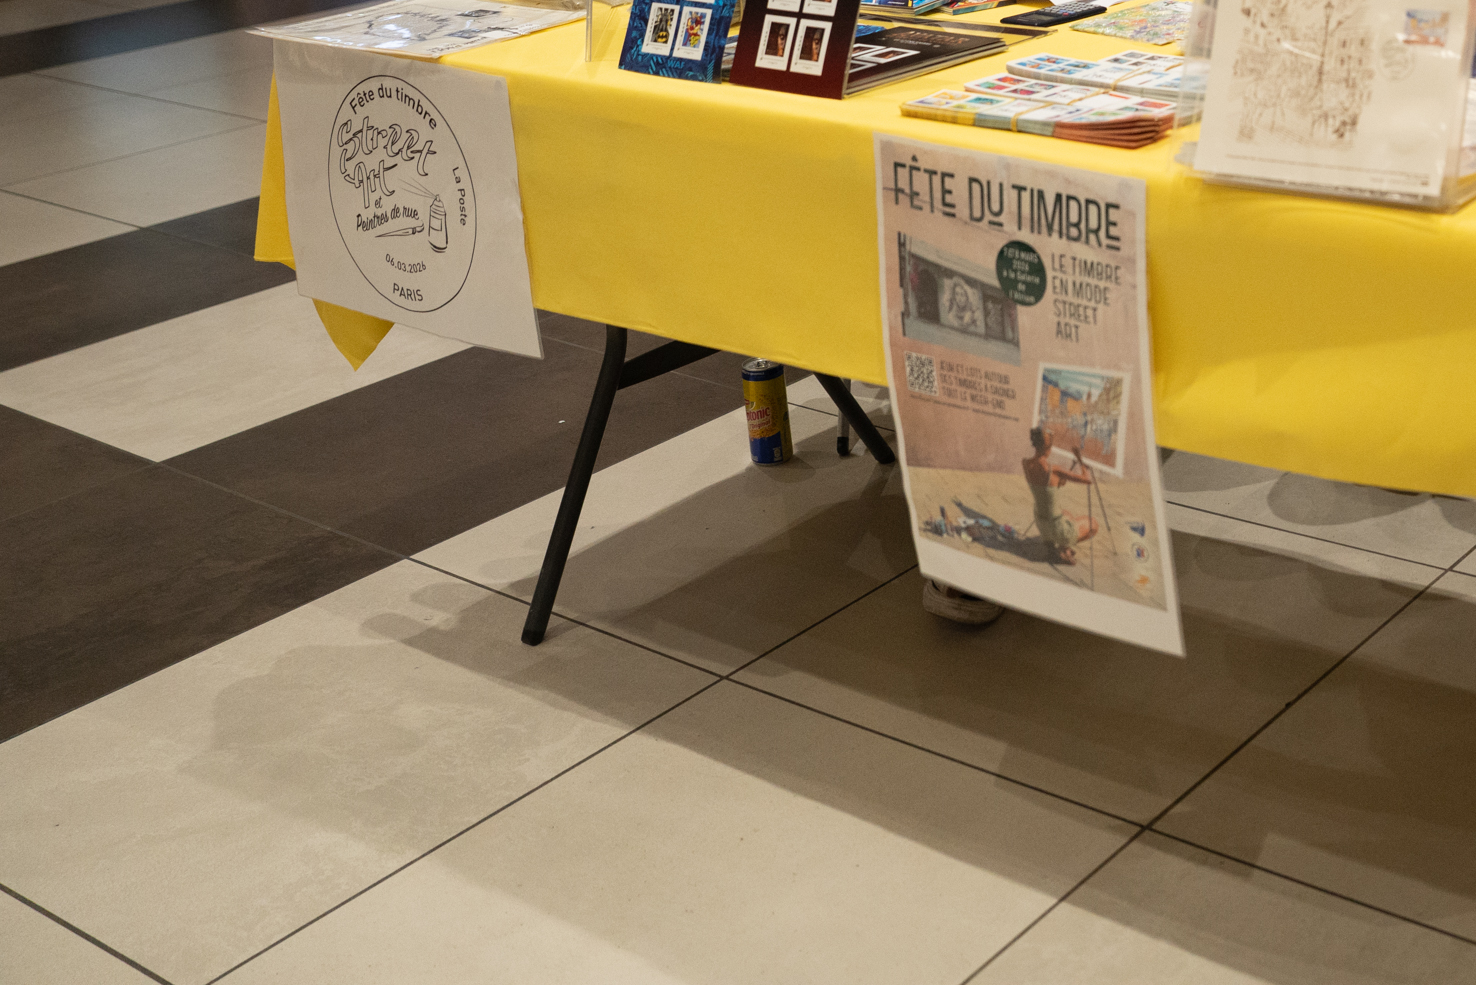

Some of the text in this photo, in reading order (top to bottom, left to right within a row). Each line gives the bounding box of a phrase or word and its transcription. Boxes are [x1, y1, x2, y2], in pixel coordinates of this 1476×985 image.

[349, 83, 437, 130] Fête du timbre
[336, 115, 438, 177] Street
[374, 196, 383, 209] et
[452, 166, 468, 226] La Poste
[893, 155, 1121, 252] FÊTE DU TIMBRE
[356, 203, 420, 232] Peintres de rue
[385, 253, 427, 274] 06.03.2026
[1051, 253, 1121, 286] LE TIMBRE
[392, 282, 424, 302] PARIS
[1052, 275, 1110, 307] EN MODE
[1053, 297, 1098, 326] STREET
[1055, 320, 1080, 344] ART
